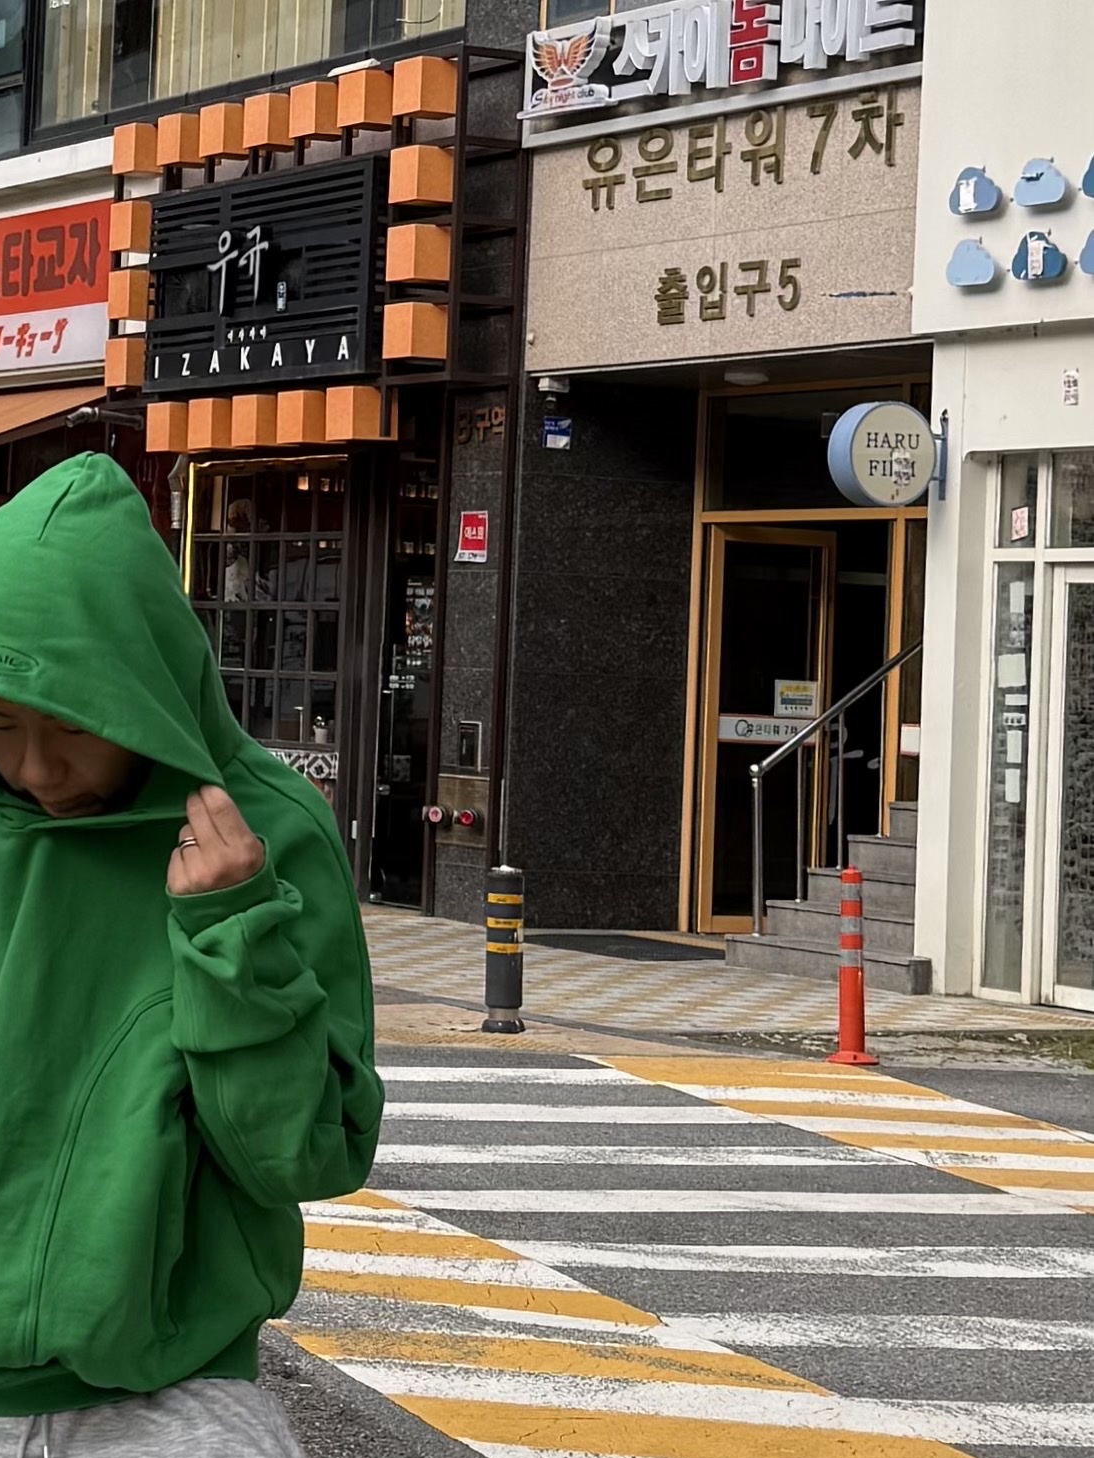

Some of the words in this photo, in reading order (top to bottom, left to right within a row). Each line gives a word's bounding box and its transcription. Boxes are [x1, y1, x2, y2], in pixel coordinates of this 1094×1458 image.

[582, 105, 788, 211] 유은타워
[806, 88, 904, 175] 7차
[654, 257, 802, 326] 출입구5
[154, 335, 350, 379] IZAKAYA
[866, 432, 920, 450] HARU
